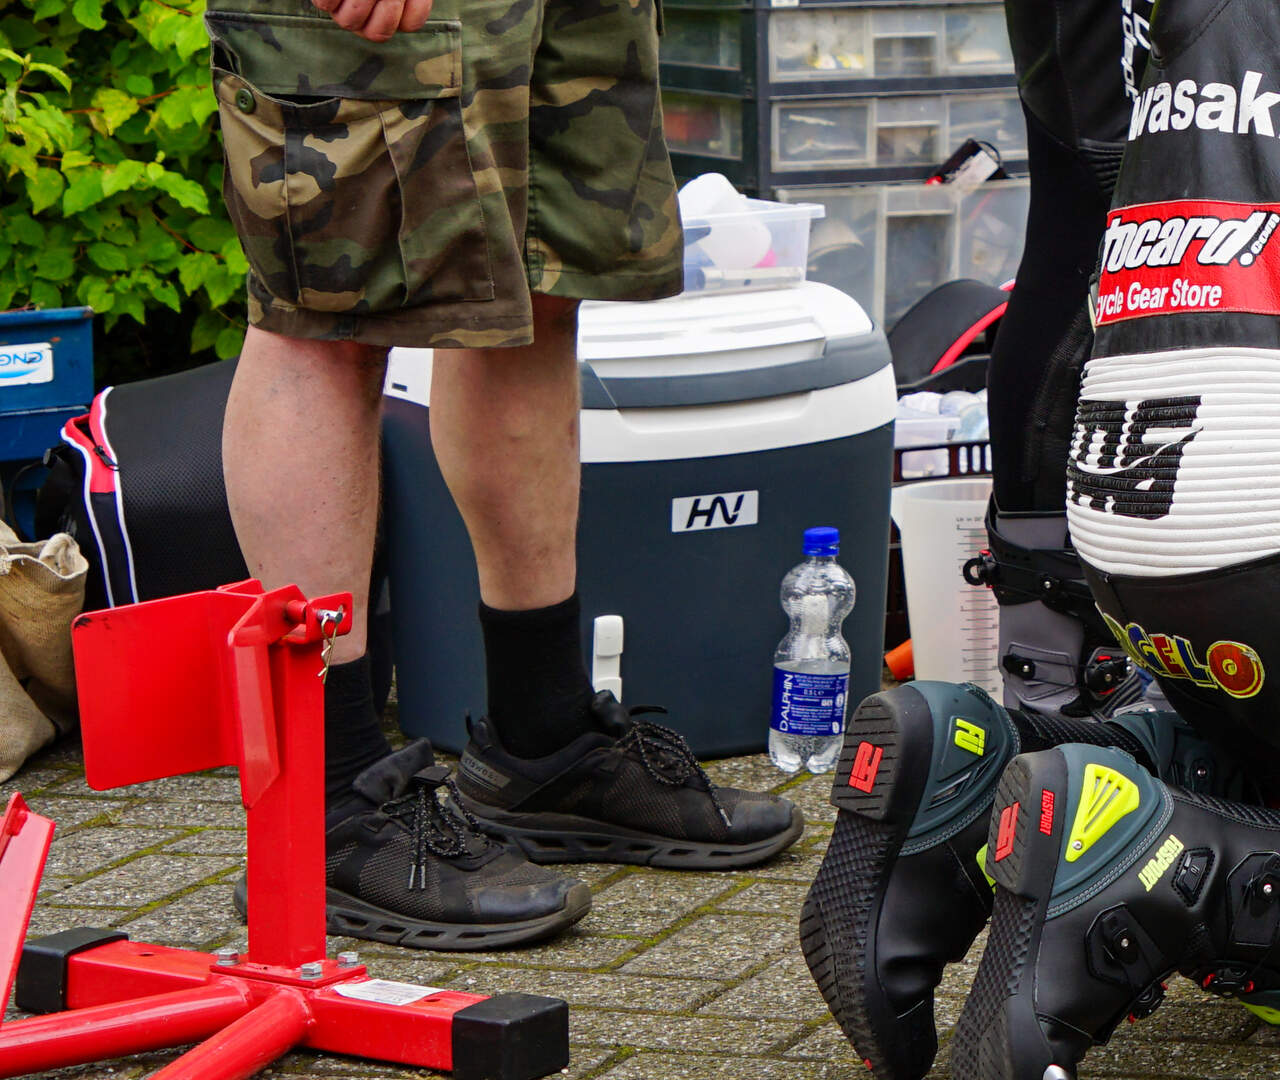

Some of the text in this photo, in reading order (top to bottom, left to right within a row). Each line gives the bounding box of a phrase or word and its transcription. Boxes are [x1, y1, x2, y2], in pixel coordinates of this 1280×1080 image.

[1127, 281, 1170, 312] Gear
[1170, 277, 1224, 307] Store
[779, 673, 794, 732] DALPHIN
